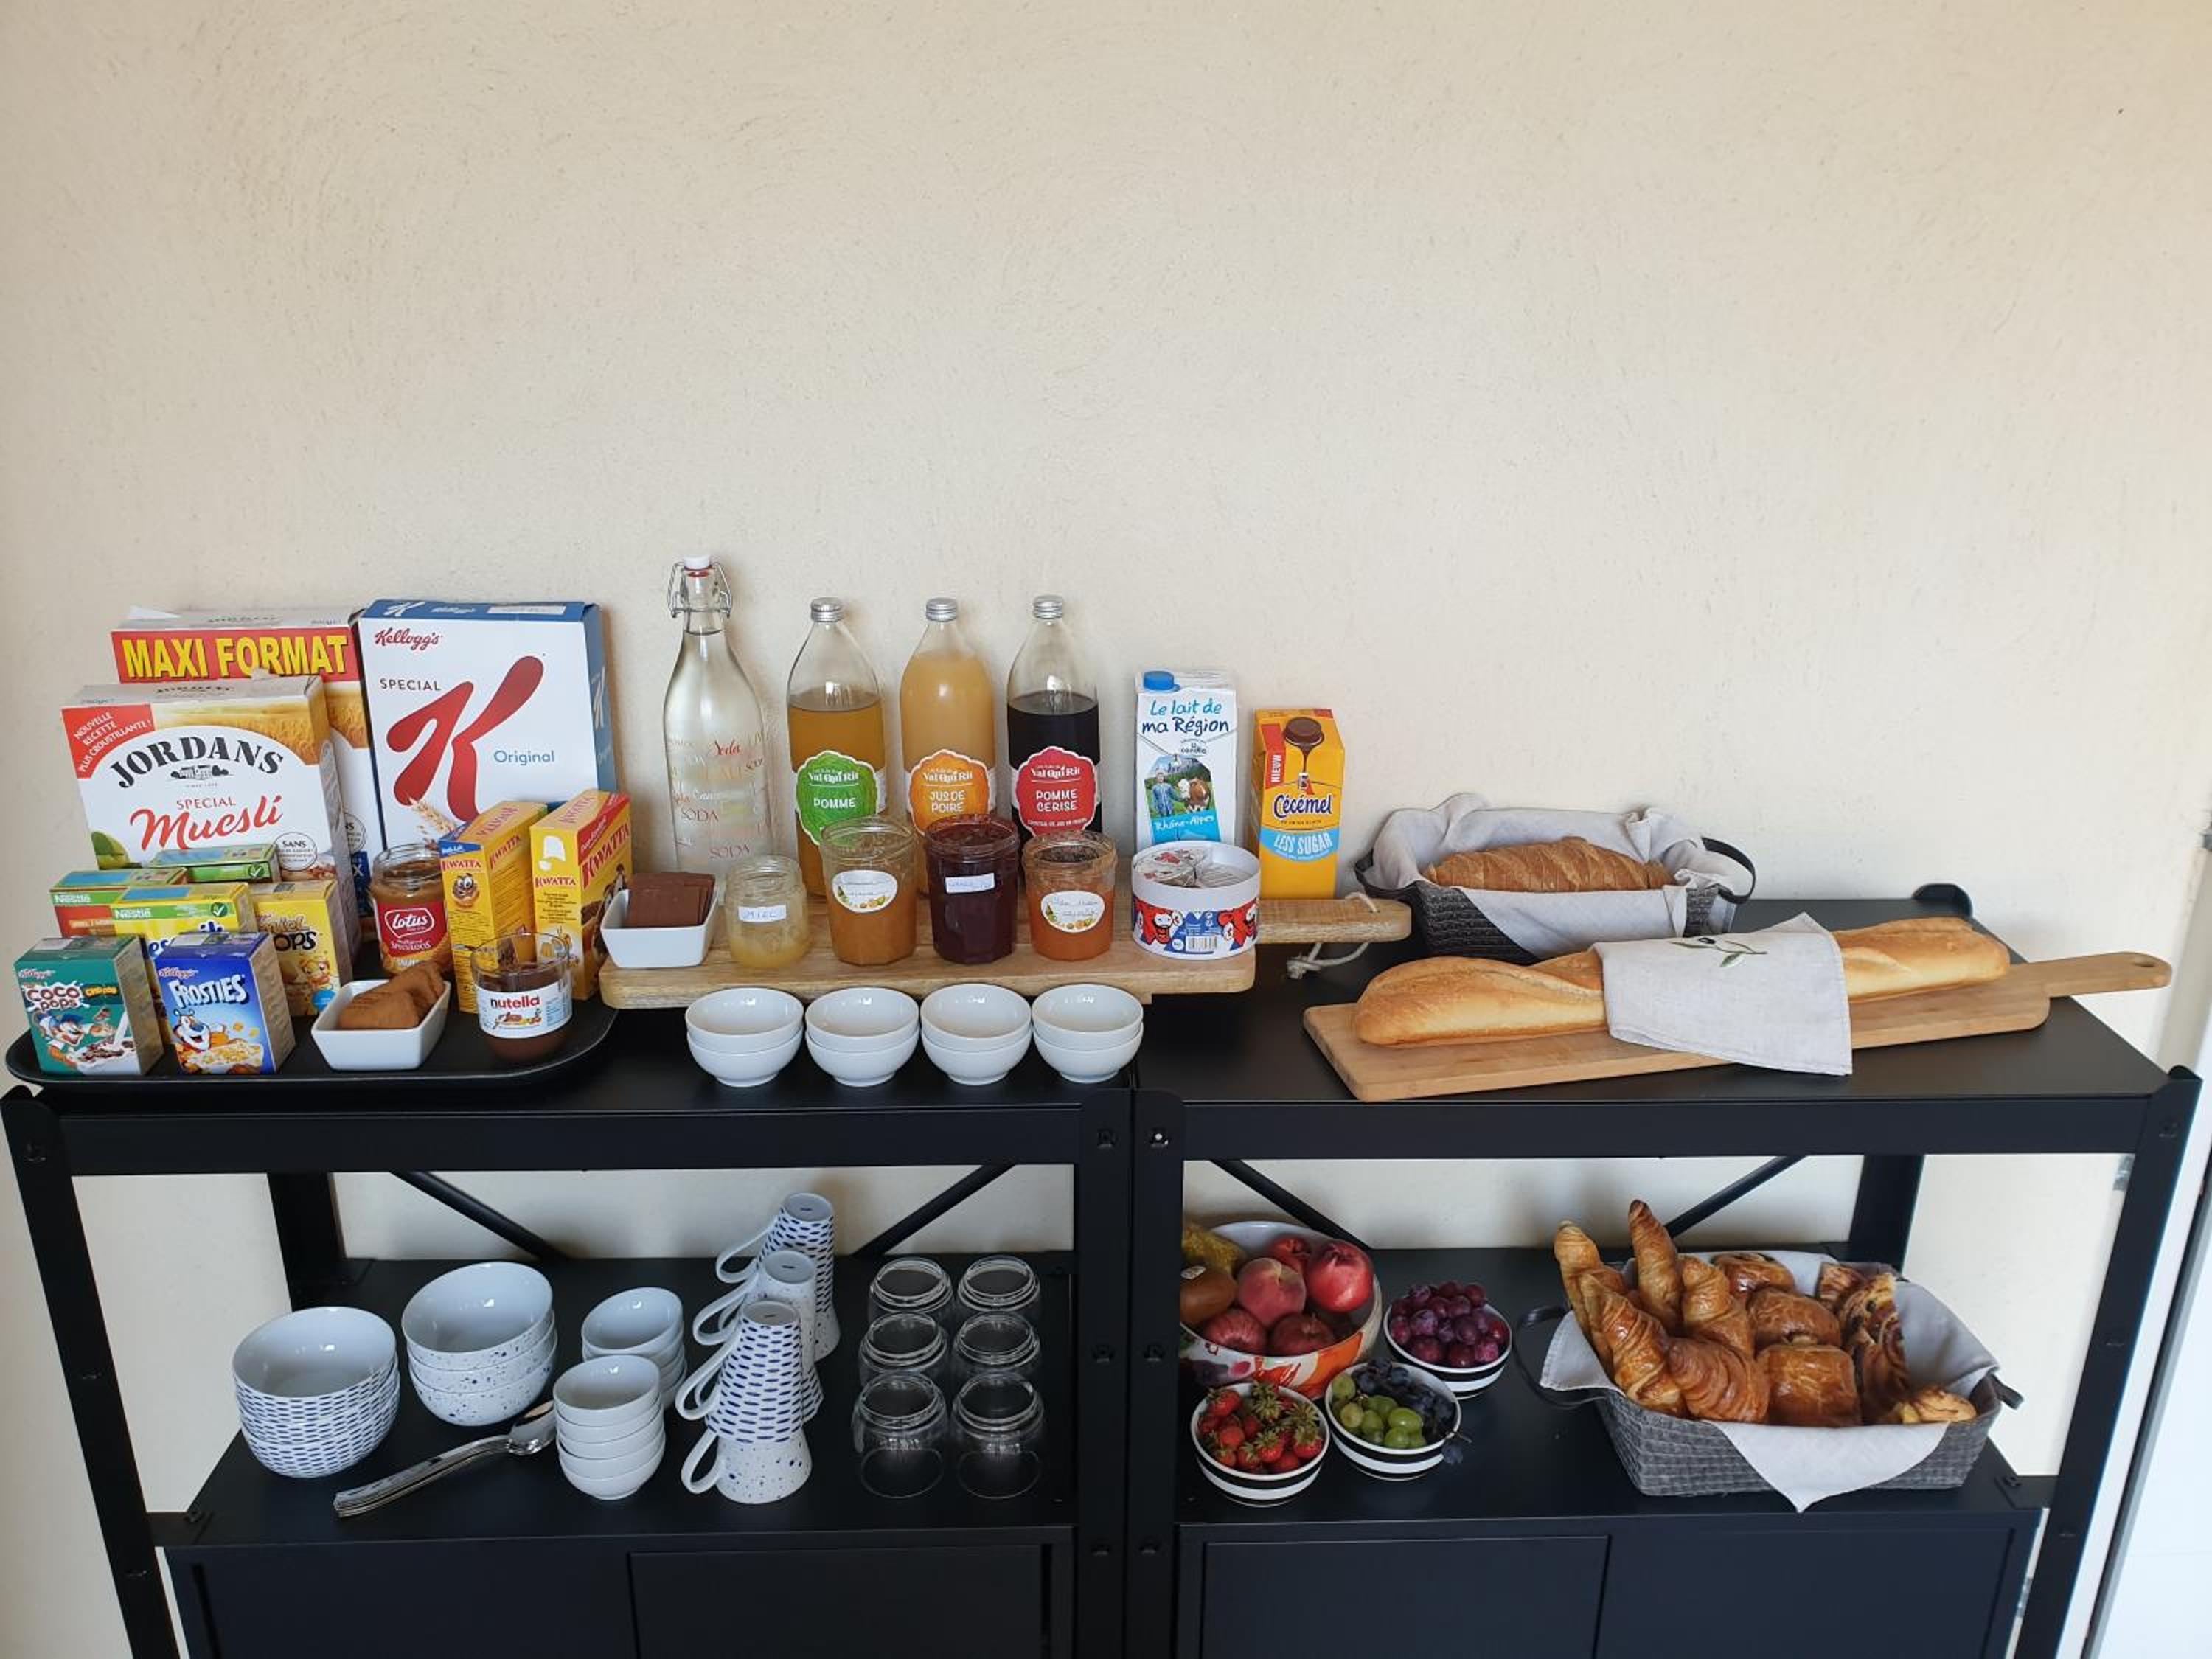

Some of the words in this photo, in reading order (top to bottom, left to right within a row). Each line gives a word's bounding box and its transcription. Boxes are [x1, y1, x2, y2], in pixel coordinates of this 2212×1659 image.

[375, 627, 441, 650] Kellogg's
[122, 638, 210, 678] MAXI
[215, 635, 349, 678] FORMAT
[380, 678, 441, 692] SPECIAL
[1150, 699, 1167, 716] Le
[1171, 699, 1200, 715] lait
[1203, 698, 1222, 714] de
[74, 712, 114, 740] NOUVELLE
[83, 720, 118, 746] RECETTE
[1142, 722, 1169, 734] ma
[1172, 716, 1229, 737] Région
[78, 756, 94, 773] PLUS
[110, 737, 284, 788] JORDANS
[493, 750, 554, 765] Original
[176, 796, 237, 810] SPECIAL
[813, 797, 856, 809] POMME
[930, 791, 949, 801] JUS
[950, 790, 965, 801] DE
[1036, 789, 1078, 801] POMME
[931, 801, 964, 813] POIRE
[1037, 800, 1077, 812] CERISE
[1273, 794, 1332, 818] Cécémel
[129, 794, 283, 850] Muesli
[1154, 815, 1215, 831] Rhône-Alpes
[1273, 833, 1295, 852] LESS
[1297, 832, 1332, 855] SUGAR
[489, 835, 520, 870] KWATTA
[582, 822, 630, 890] KWATTA
[441, 860, 481, 872] KWATTA
[535, 877, 576, 888] KWATTA
[392, 914, 428, 929] Lotus
[272, 931, 317, 951] OPS
[168, 974, 248, 1008] FROSTIES
[490, 995, 540, 1009] nutella
